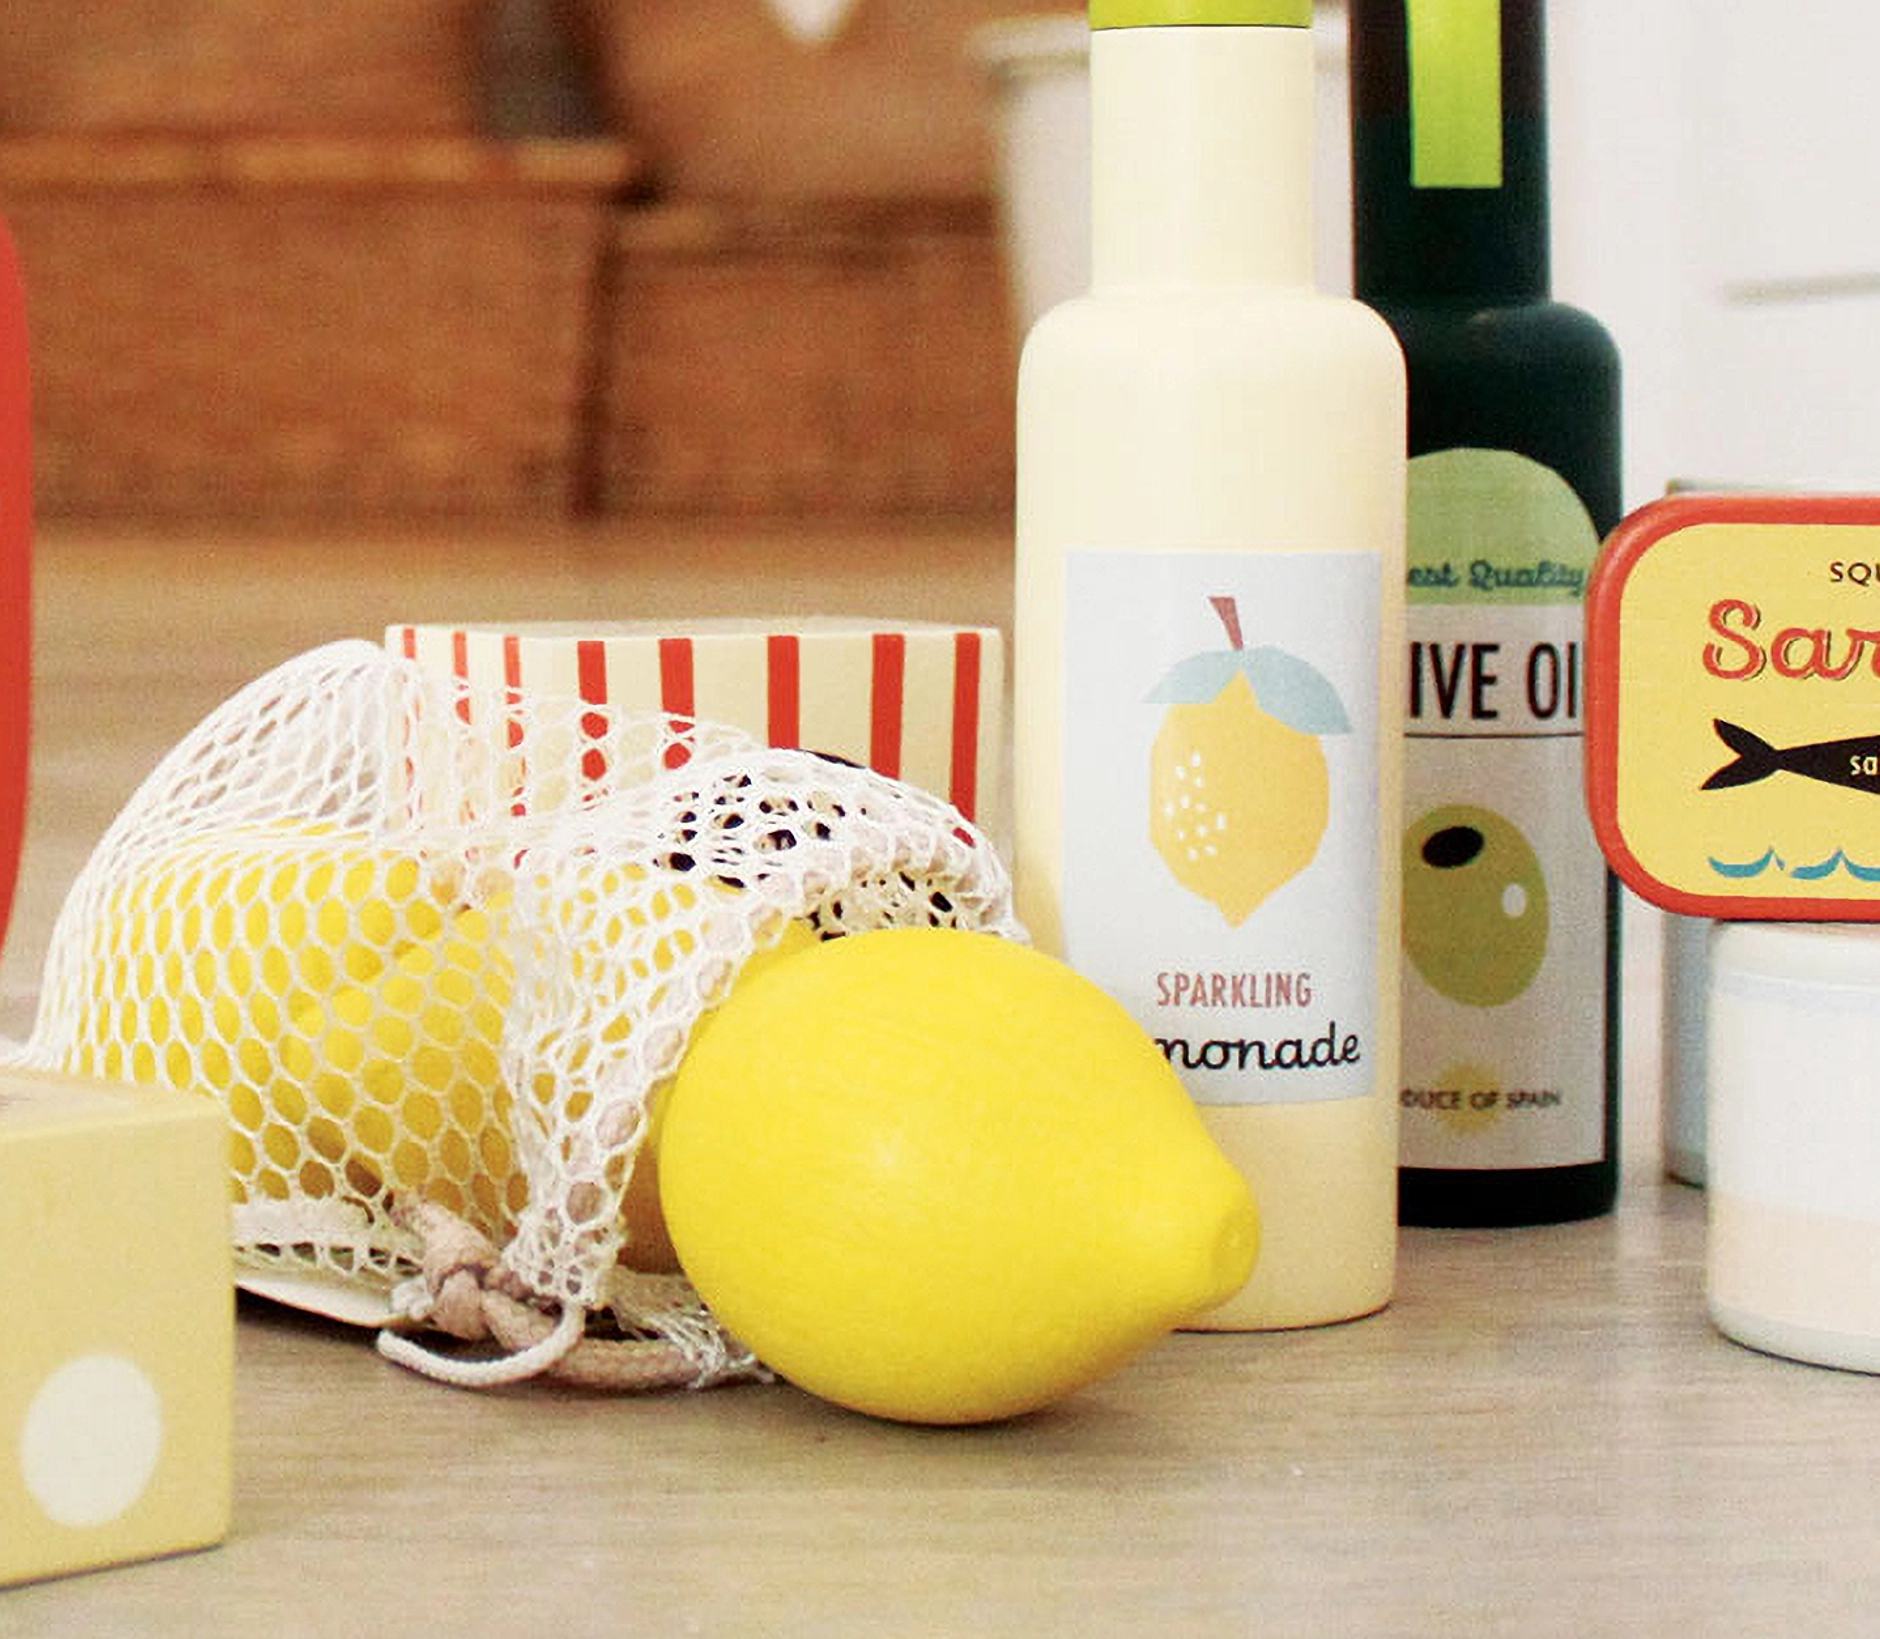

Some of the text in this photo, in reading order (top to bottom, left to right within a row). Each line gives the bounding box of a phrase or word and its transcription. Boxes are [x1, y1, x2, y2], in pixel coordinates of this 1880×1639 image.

[1471, 558, 1585, 598] Quality
[1829, 560, 1880, 587] SQ
[1409, 641, 1577, 719] IVE OI
[1157, 972, 1312, 1008] SPARKLING
[1470, 1090, 1498, 1110] OF
